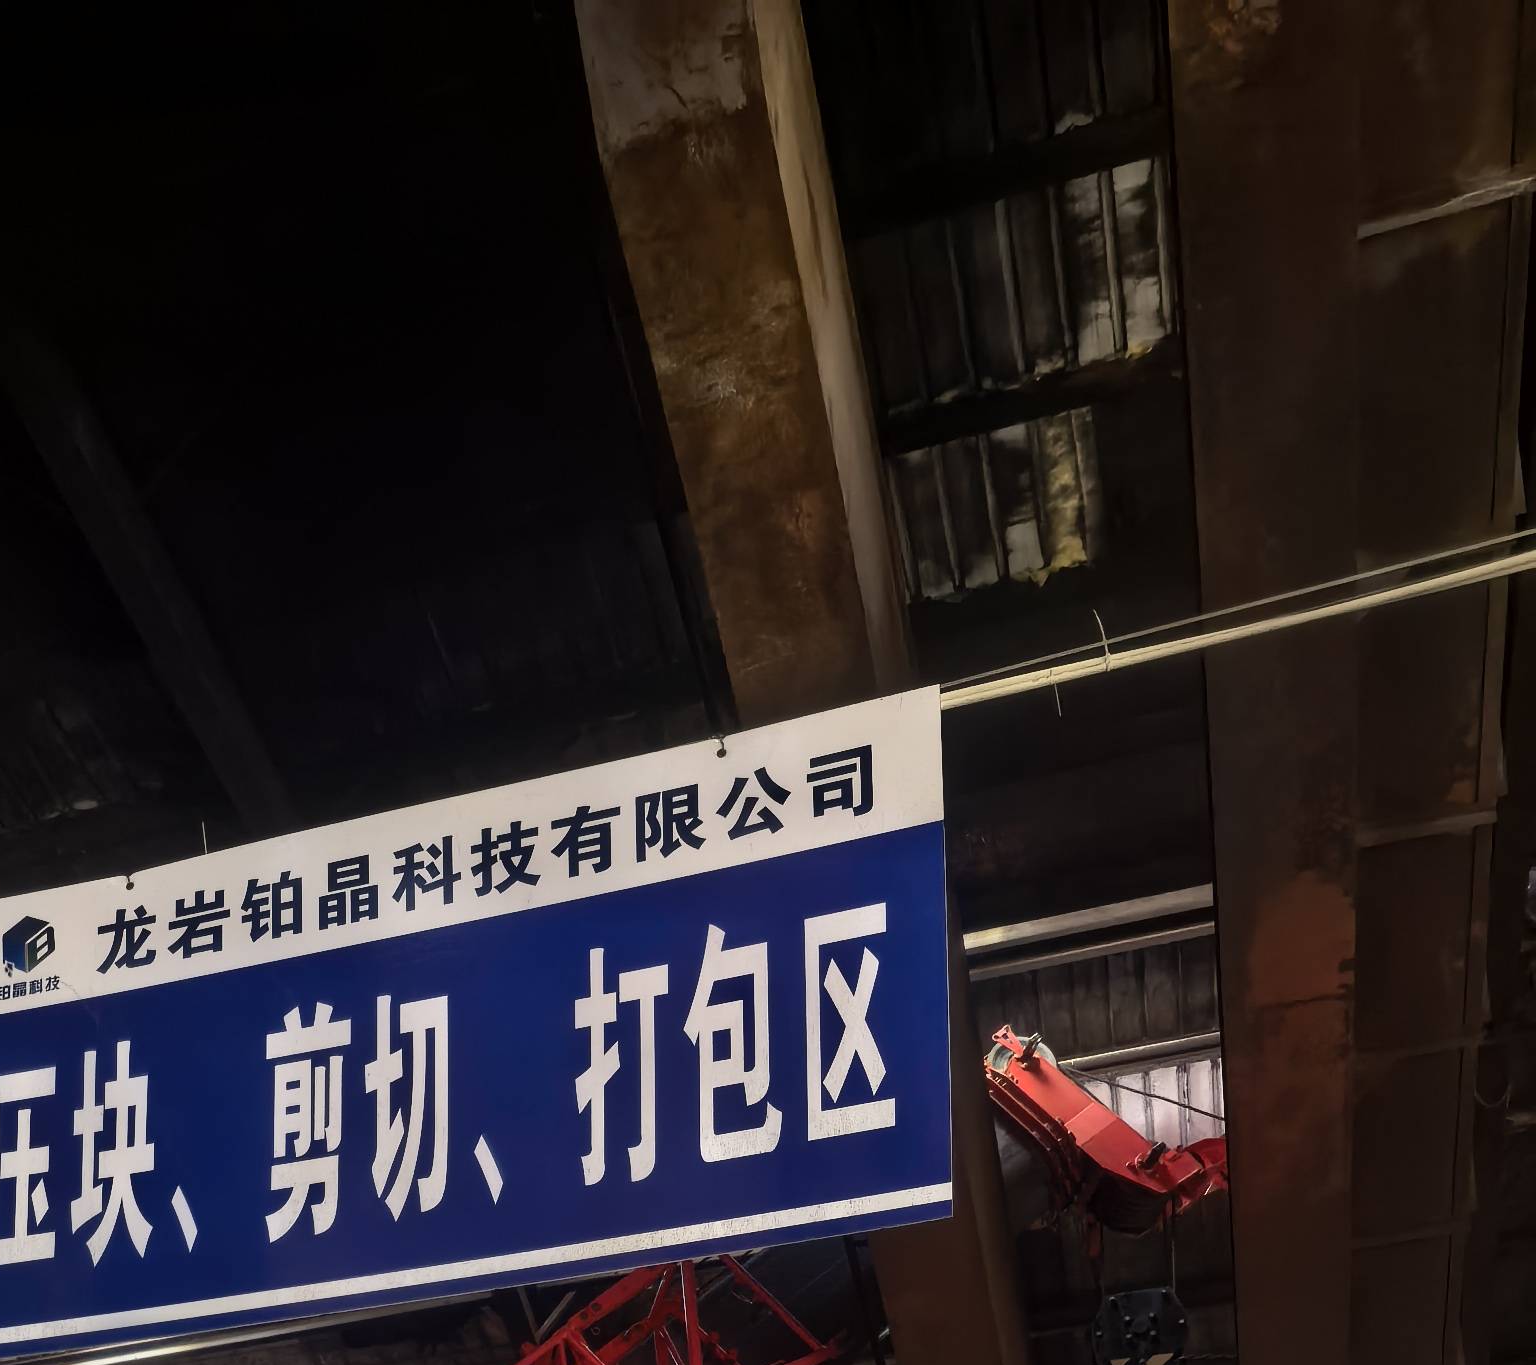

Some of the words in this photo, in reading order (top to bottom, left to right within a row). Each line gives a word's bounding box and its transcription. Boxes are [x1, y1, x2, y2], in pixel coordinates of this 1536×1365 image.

[96, 744, 875, 975] 龙岩铂晶科技有限公司
